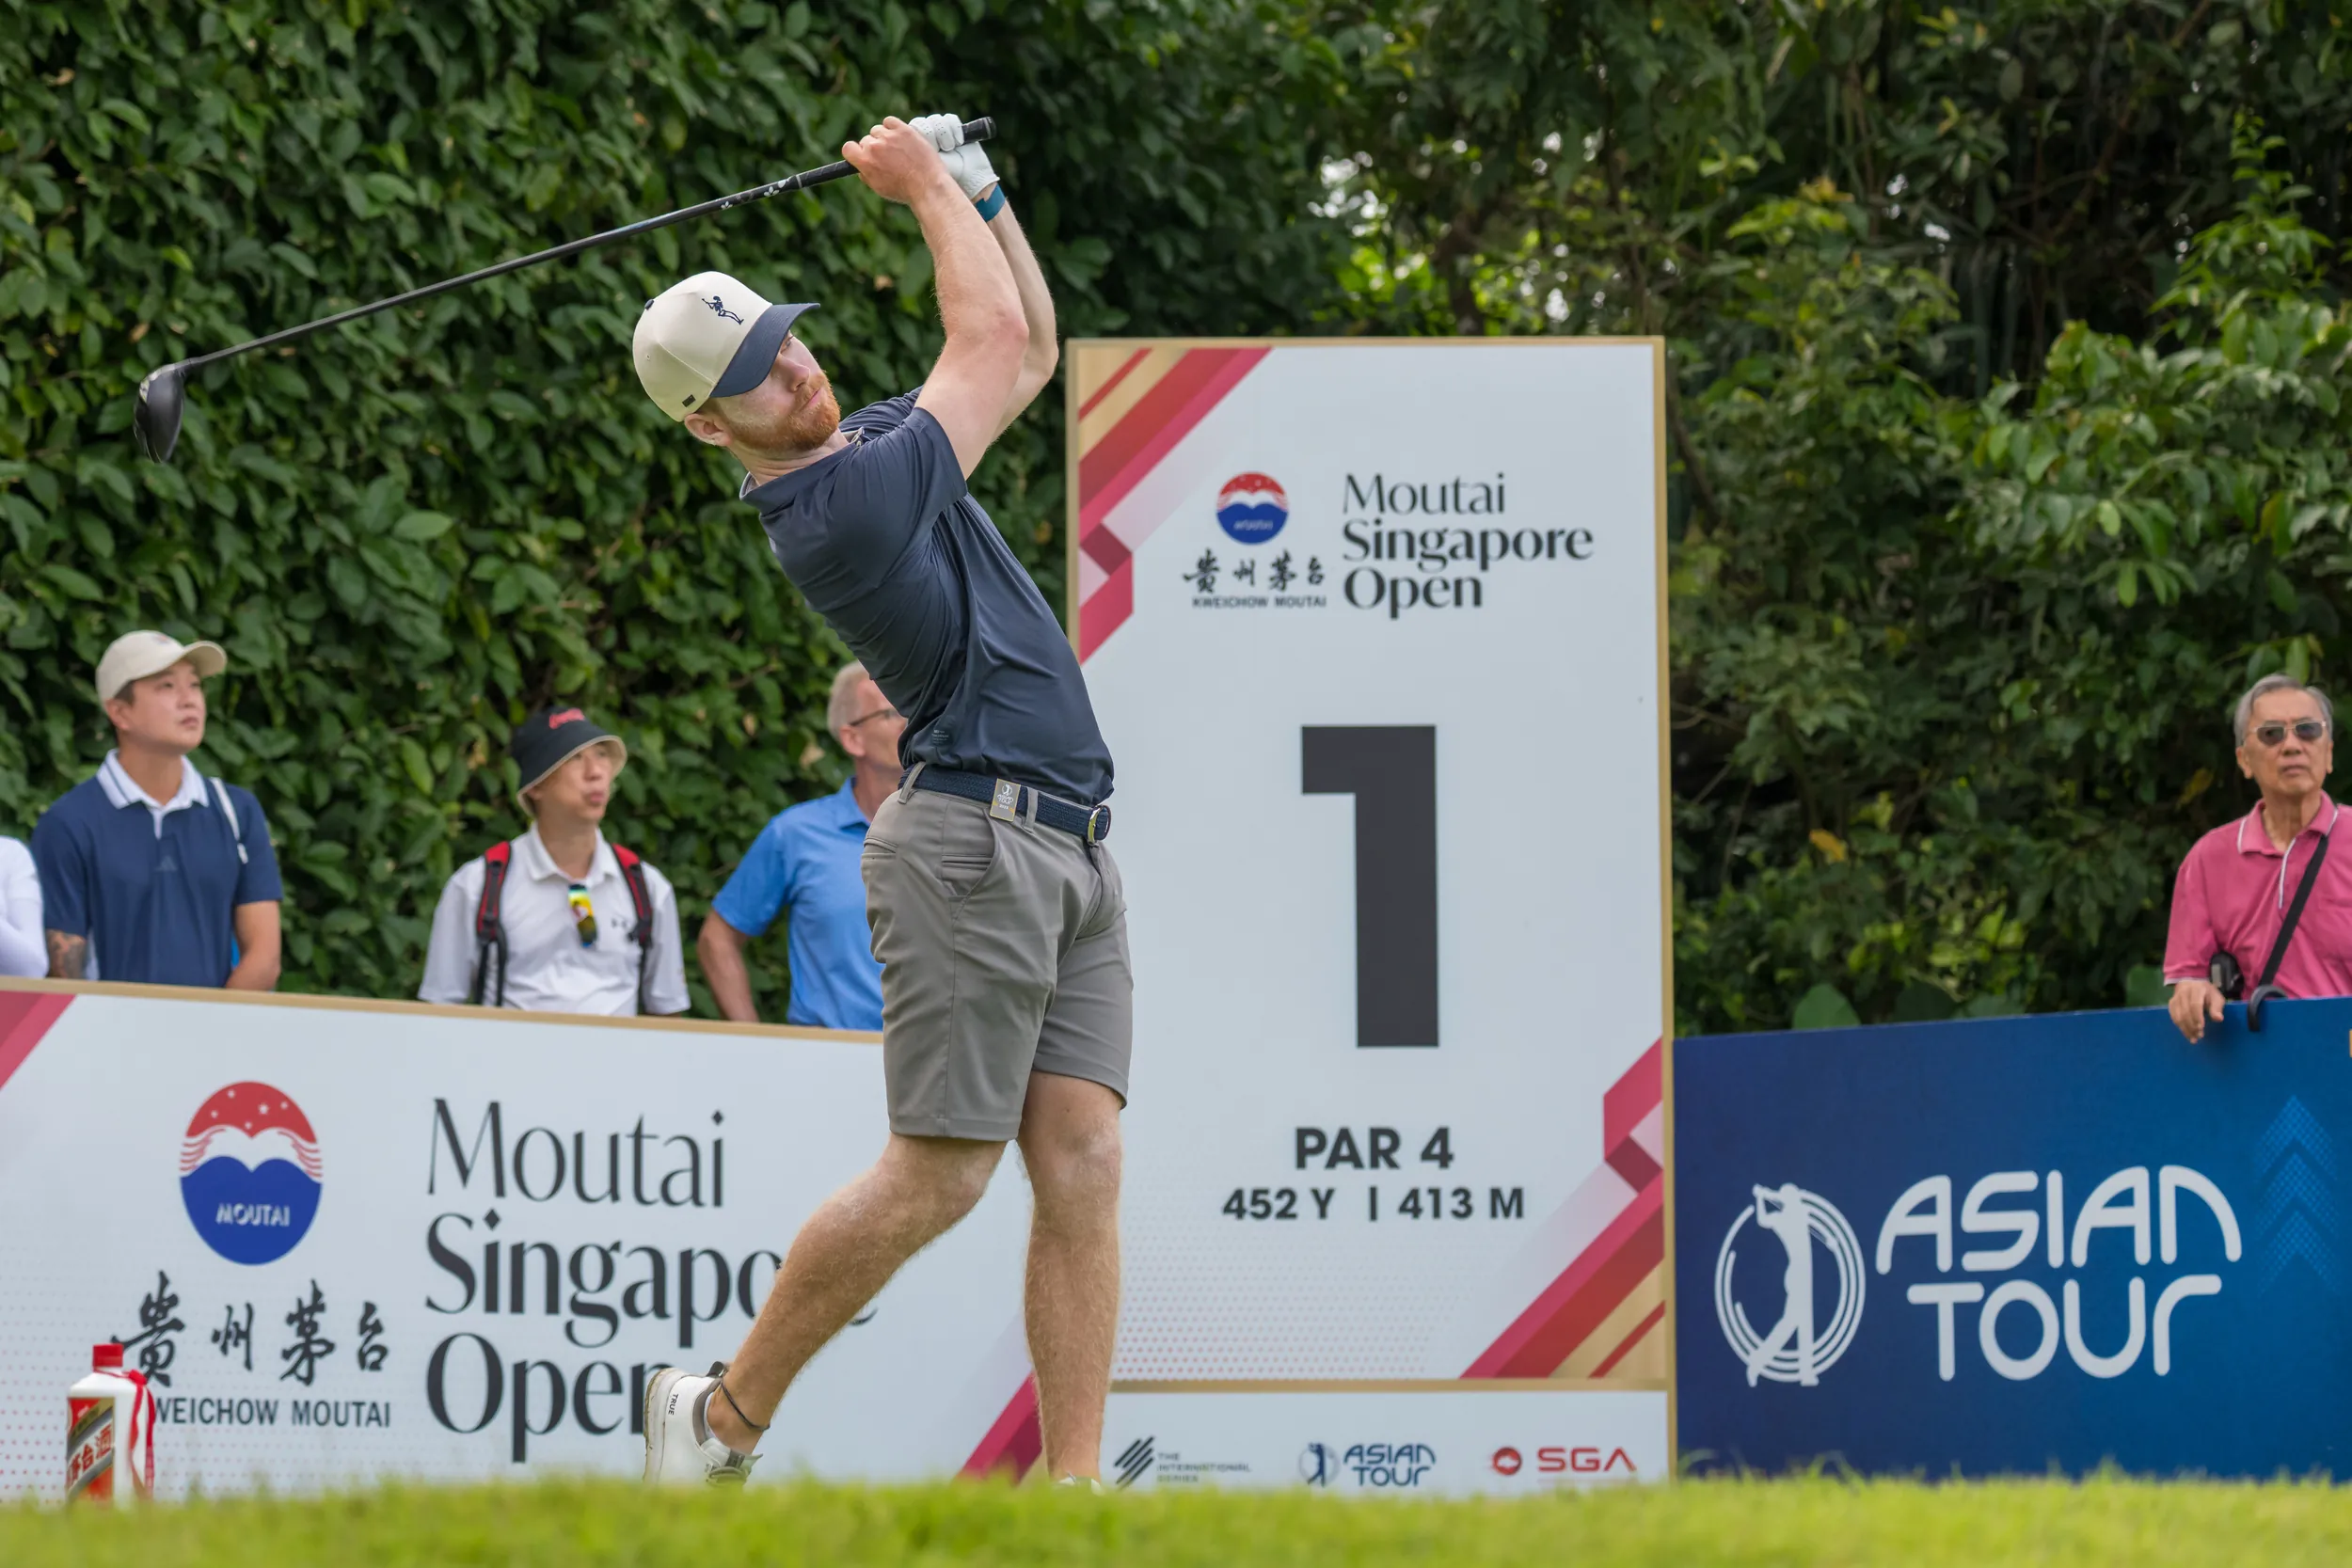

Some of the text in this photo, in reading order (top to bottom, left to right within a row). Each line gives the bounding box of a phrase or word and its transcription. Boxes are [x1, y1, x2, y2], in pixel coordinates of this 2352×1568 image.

[1343, 472, 1504, 515] Moutai
[1343, 517, 1594, 573] Singapore
[1192, 595, 1327, 608] KWEICHOW MOUTAI
[1343, 566, 1483, 620] Open
[1301, 725, 1439, 1048] 1
[427, 1098, 724, 1208] Moutai
[1295, 1127, 1454, 1169] PAR 4
[215, 1203, 291, 1227] MOUTAI
[1222, 1187, 1297, 1220] 452
[1310, 1188, 1336, 1219] Y
[1398, 1187, 1473, 1220] 413
[1489, 1187, 1523, 1219] M
[1876, 1164, 2242, 1275] ASIAN
[425, 1208, 879, 1349] Singapo
[1907, 1274, 2222, 1381] TOUR
[153, 1397, 391, 1428] WEICHOW MOUTAI
[668, 1393, 679, 1416] TRUE
[1343, 1443, 1437, 1465] ASIAN
[1353, 1465, 1434, 1487] TOUR
